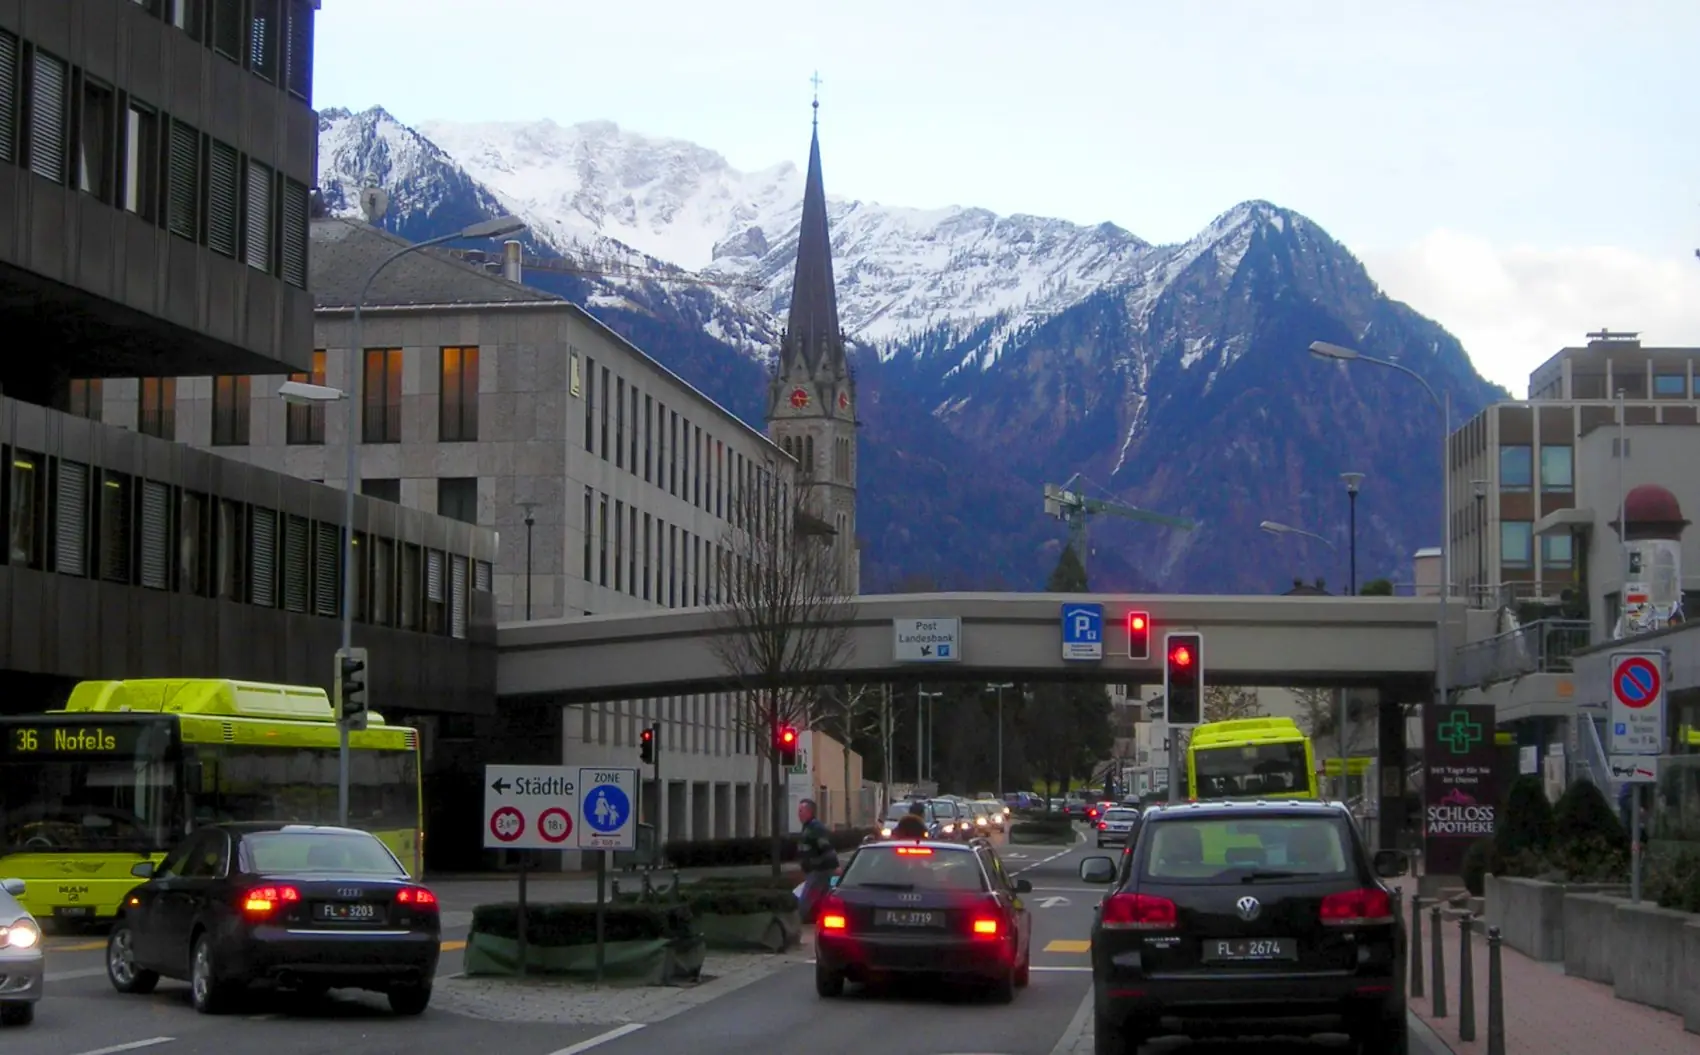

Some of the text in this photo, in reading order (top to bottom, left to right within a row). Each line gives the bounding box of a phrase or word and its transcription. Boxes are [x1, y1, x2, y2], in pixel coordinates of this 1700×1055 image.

[915, 621, 937, 631] Post
[1075, 616, 1090, 638] P
[898, 633, 954, 643] Landesbank
[16, 727, 116, 752] 36 Nofels
[594, 773, 620, 783] ZONE
[515, 775, 574, 796] Städtle
[1427, 806, 1494, 821] SCHLOSS
[1428, 822, 1494, 834] APOTHEKE
[324, 904, 374, 916] FL 3203
[886, 912, 898, 922] FL
[1217, 941, 1281, 956] FL 2674
